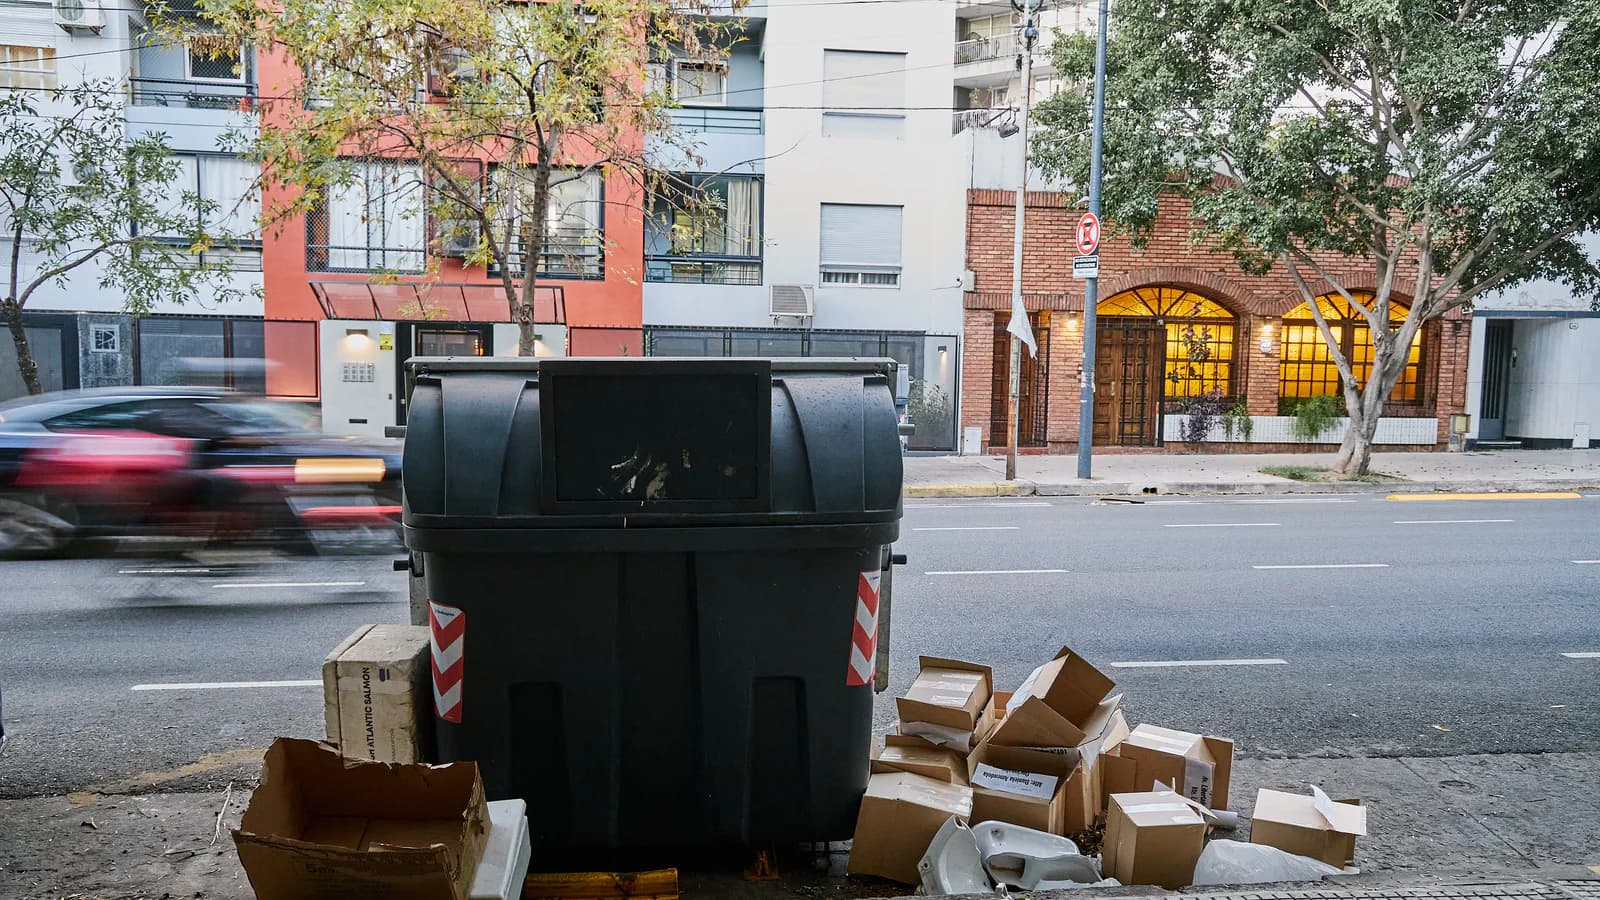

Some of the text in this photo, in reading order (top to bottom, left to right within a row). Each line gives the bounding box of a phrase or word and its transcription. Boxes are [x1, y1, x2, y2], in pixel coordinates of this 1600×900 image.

[362, 667, 372, 705] SALMON
[364, 706, 375, 748] ATLANTIC
[1010, 777, 1030, 785] Daniela
